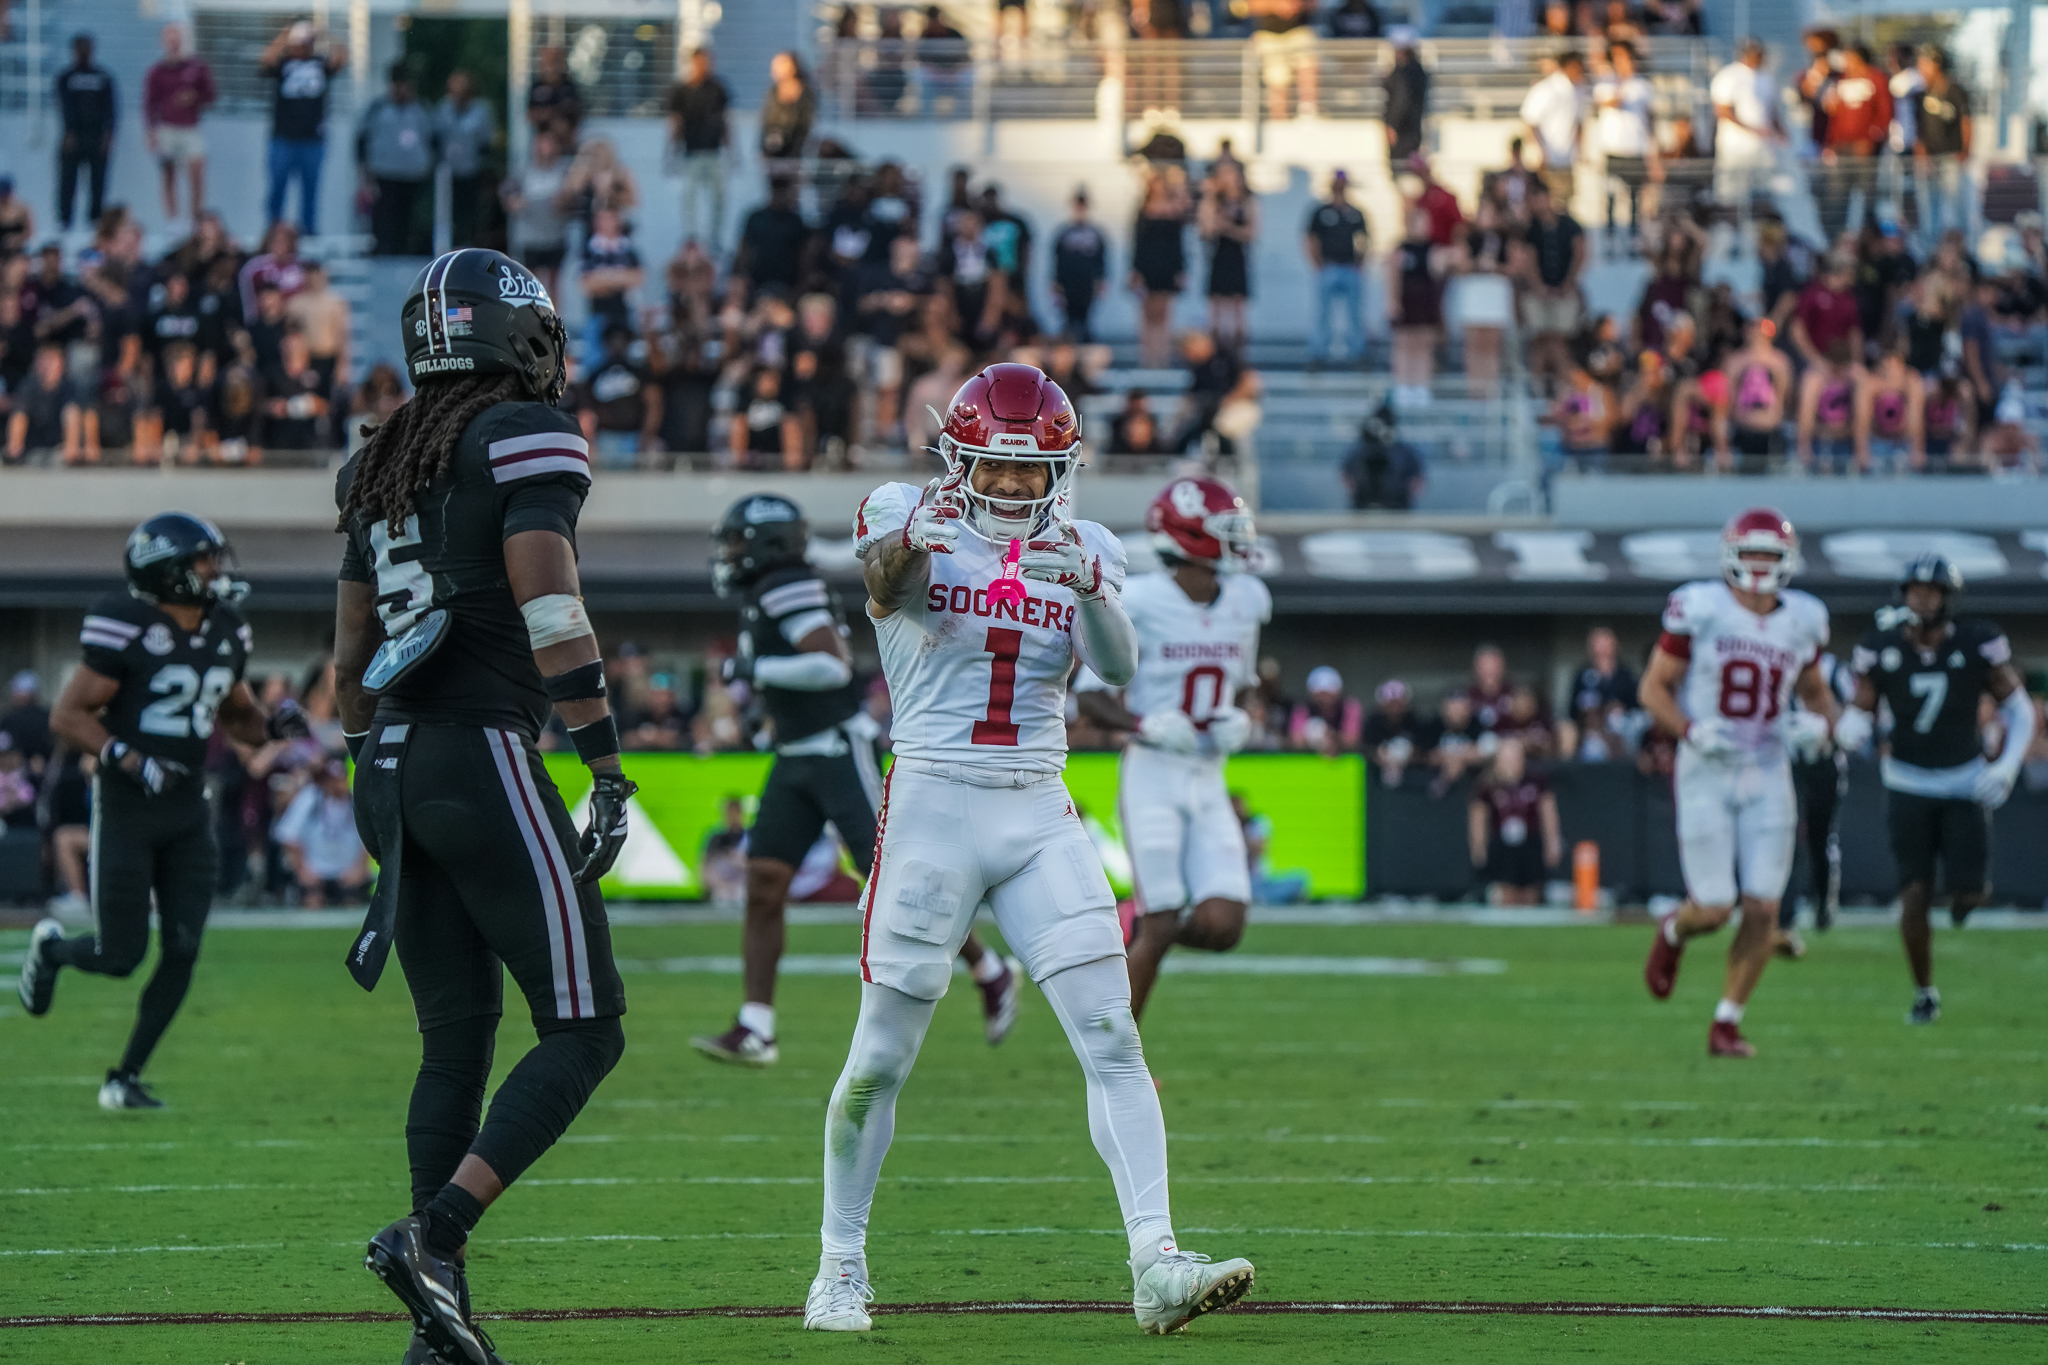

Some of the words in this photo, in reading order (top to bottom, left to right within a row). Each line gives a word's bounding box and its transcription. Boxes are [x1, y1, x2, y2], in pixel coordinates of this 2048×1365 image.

[415, 320, 427, 337] SEC
[414, 357, 475, 375] BULLDOGS
[1000, 438, 1028, 446] OKLAHOMA
[370, 513, 434, 637] 5
[1161, 643, 1242, 659] SOONER
[139, 664, 235, 739] 28
[971, 627, 1024, 746] 1
[1182, 666, 1225, 731] 0
[1719, 660, 1783, 721] 81
[1909, 671, 1949, 735] 7
